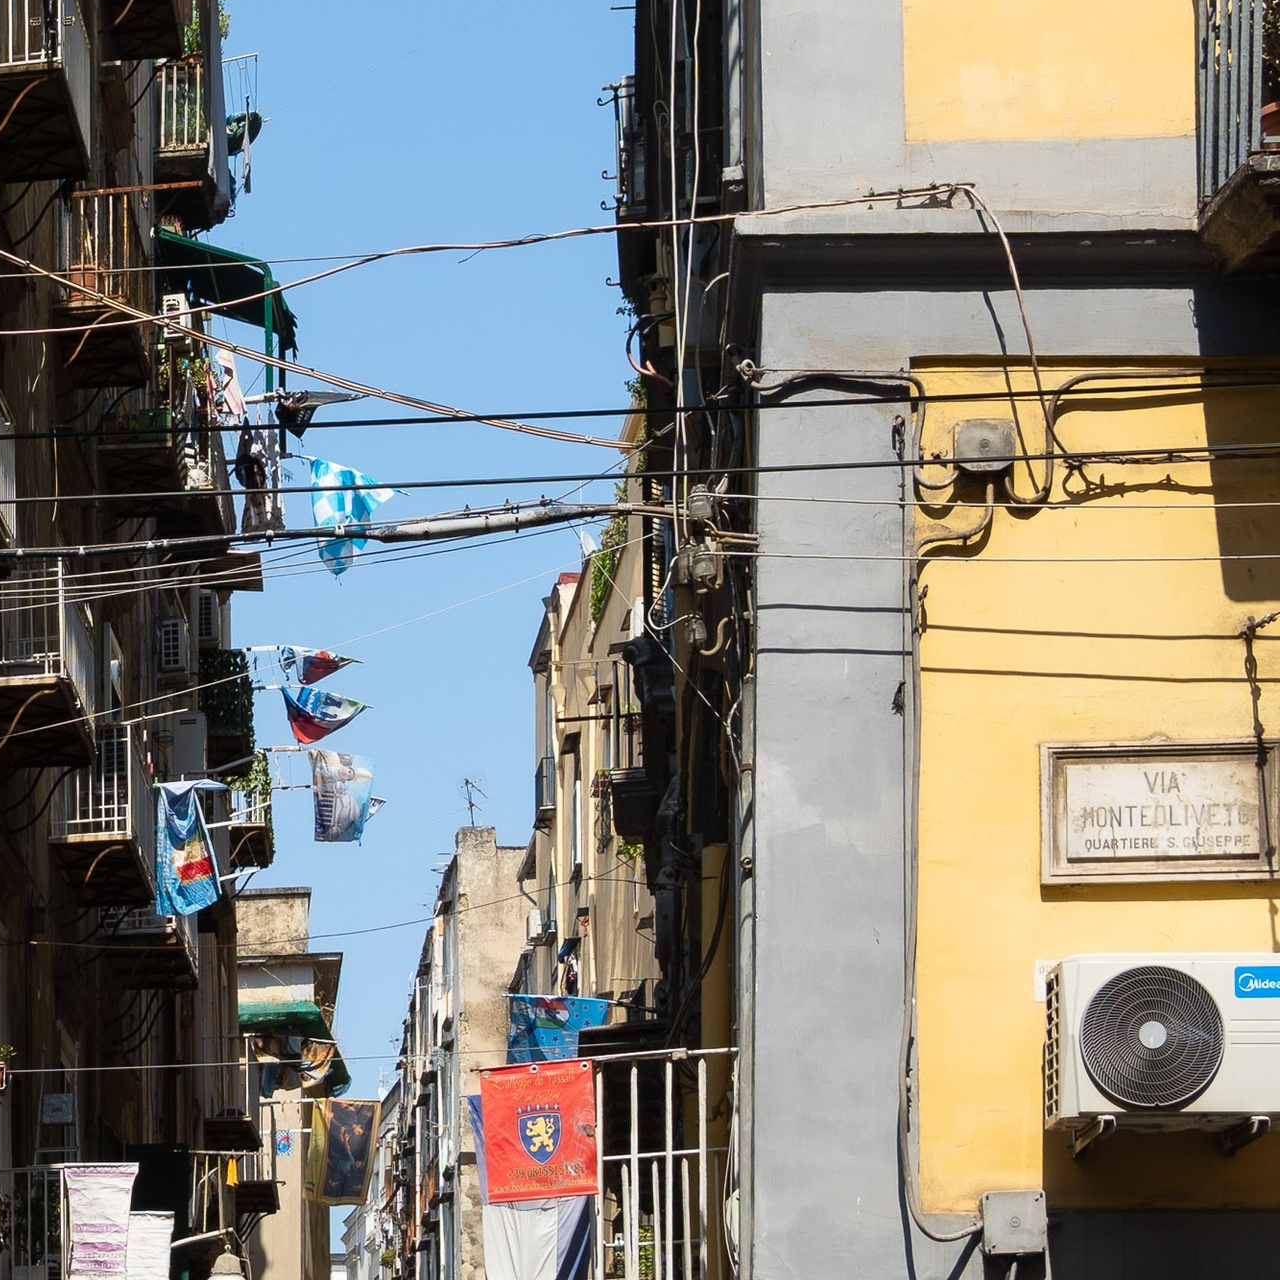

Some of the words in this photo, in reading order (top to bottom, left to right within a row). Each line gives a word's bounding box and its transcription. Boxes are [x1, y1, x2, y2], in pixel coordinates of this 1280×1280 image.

[1144, 772, 1181, 793] VIA
[1082, 803, 1251, 828] MONTEOLIVETO
[1085, 837, 1157, 852] QUARTIERE
[1167, 837, 1179, 848] S.
[1183, 835, 1251, 850] GIUSEPPE
